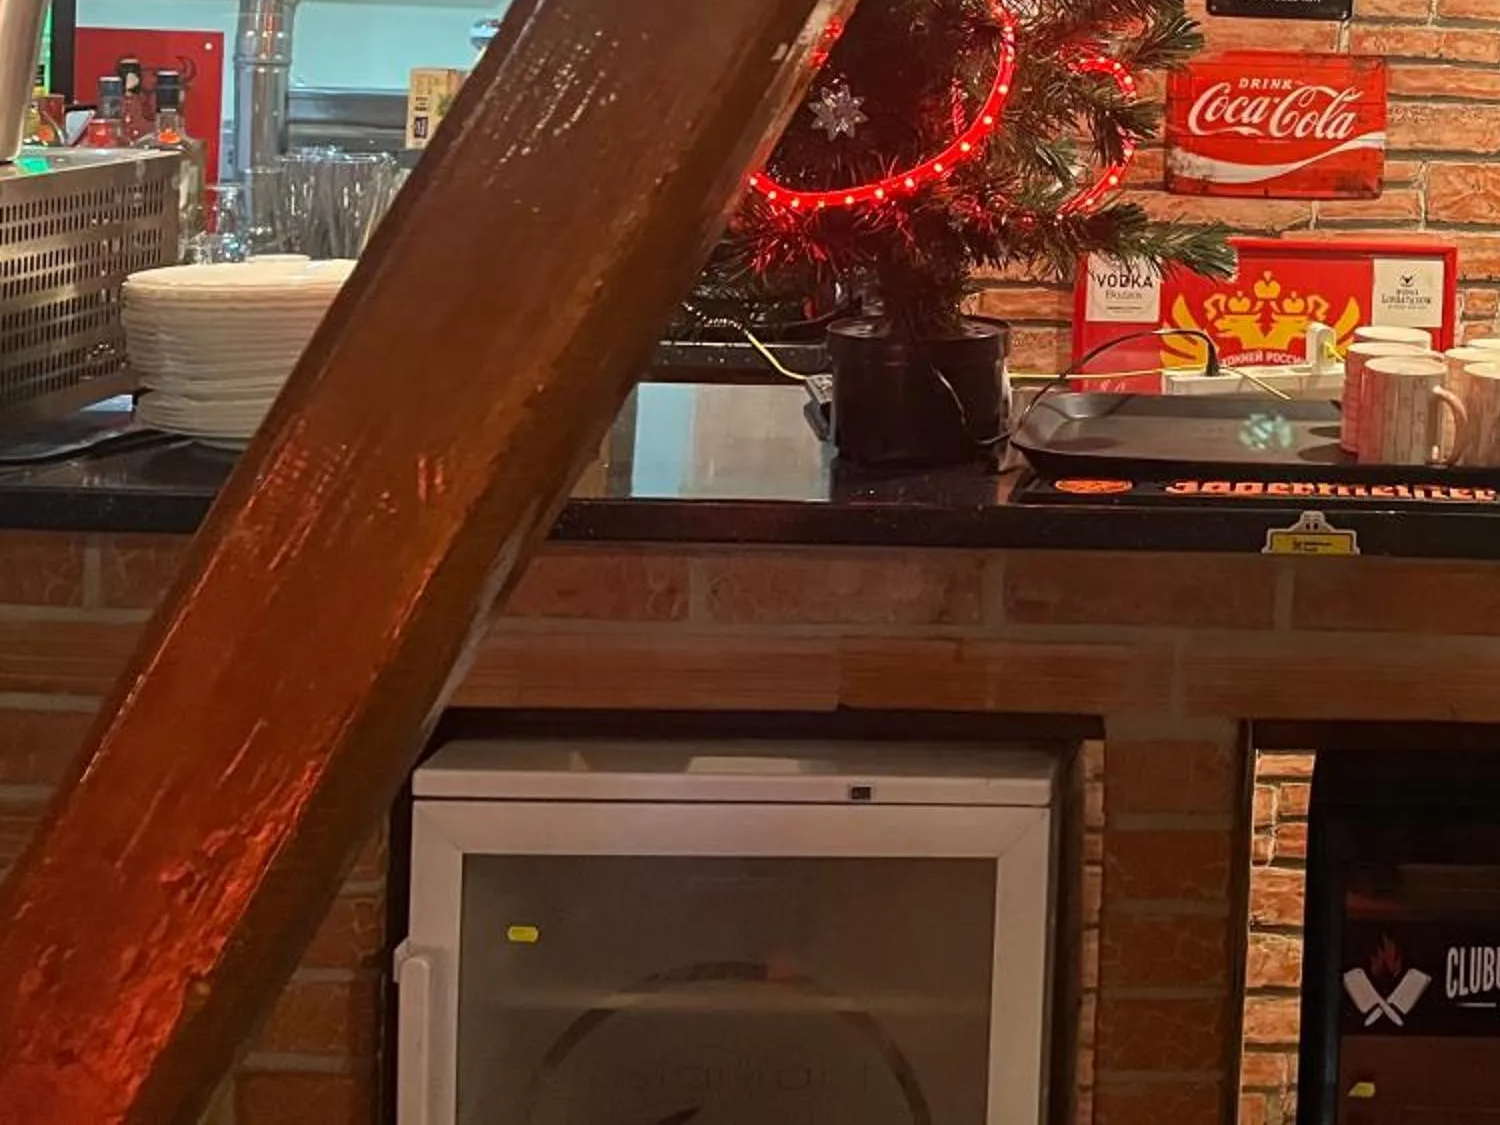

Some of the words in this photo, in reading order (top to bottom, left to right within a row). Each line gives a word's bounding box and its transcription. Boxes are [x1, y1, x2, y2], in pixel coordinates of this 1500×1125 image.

[1238, 78, 1293, 91] DRINK
[1188, 82, 1364, 140] Coca-Cola
[1096, 274, 1153, 289] VODKA
